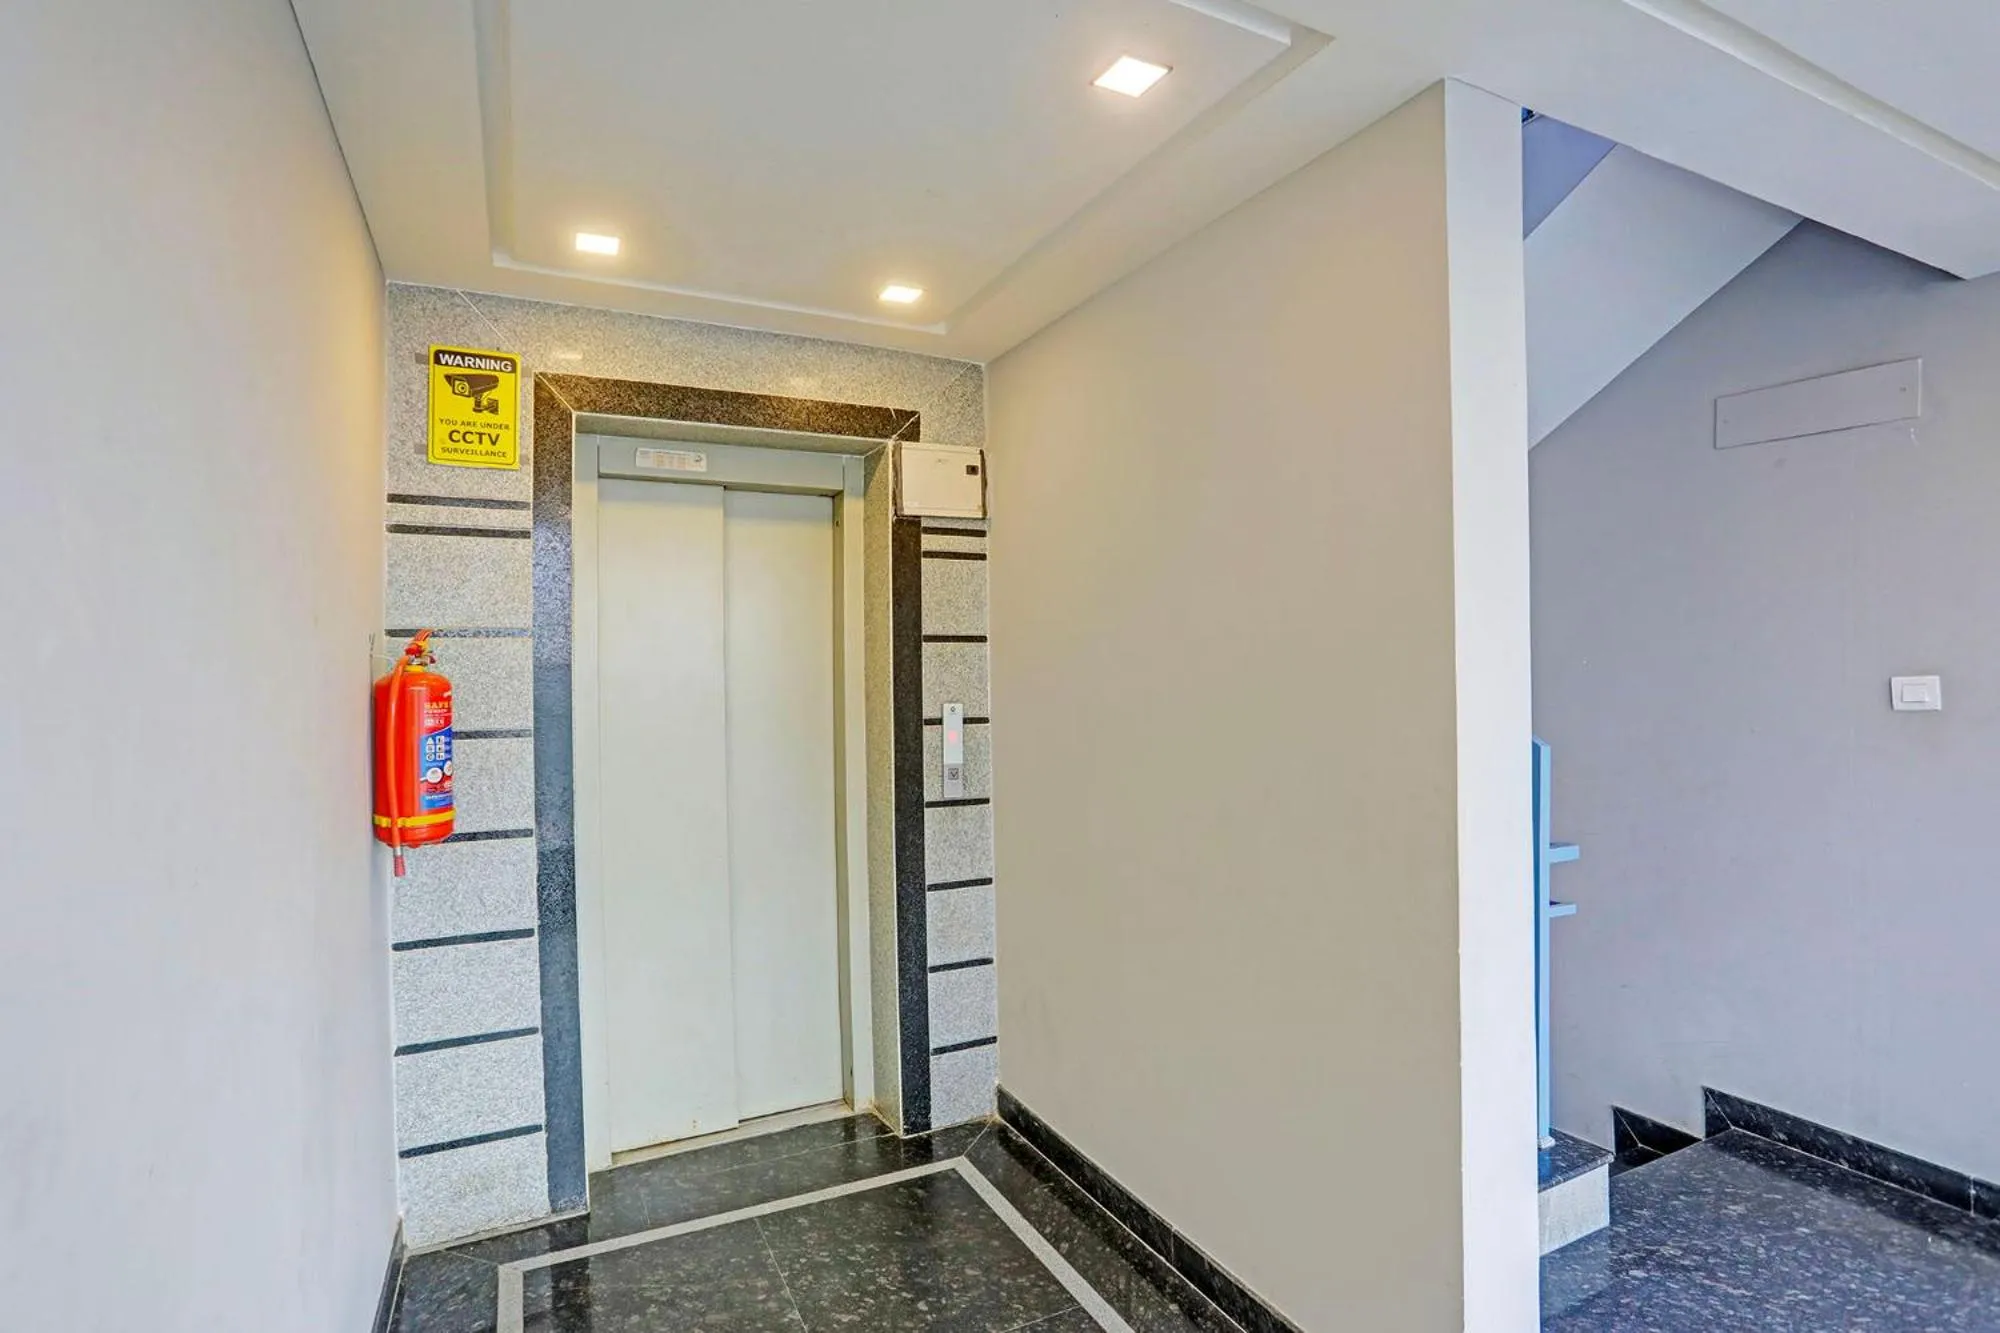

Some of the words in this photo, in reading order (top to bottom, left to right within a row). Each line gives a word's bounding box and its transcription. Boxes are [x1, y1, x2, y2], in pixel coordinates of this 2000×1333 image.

[439, 353, 512, 372] WARNING
[439, 418, 458, 426] YOU
[460, 419, 477, 428] ARE
[480, 421, 510, 430] UNDER
[448, 429, 500, 446] CCTV
[441, 446, 508, 458] SURVEILLANCE
